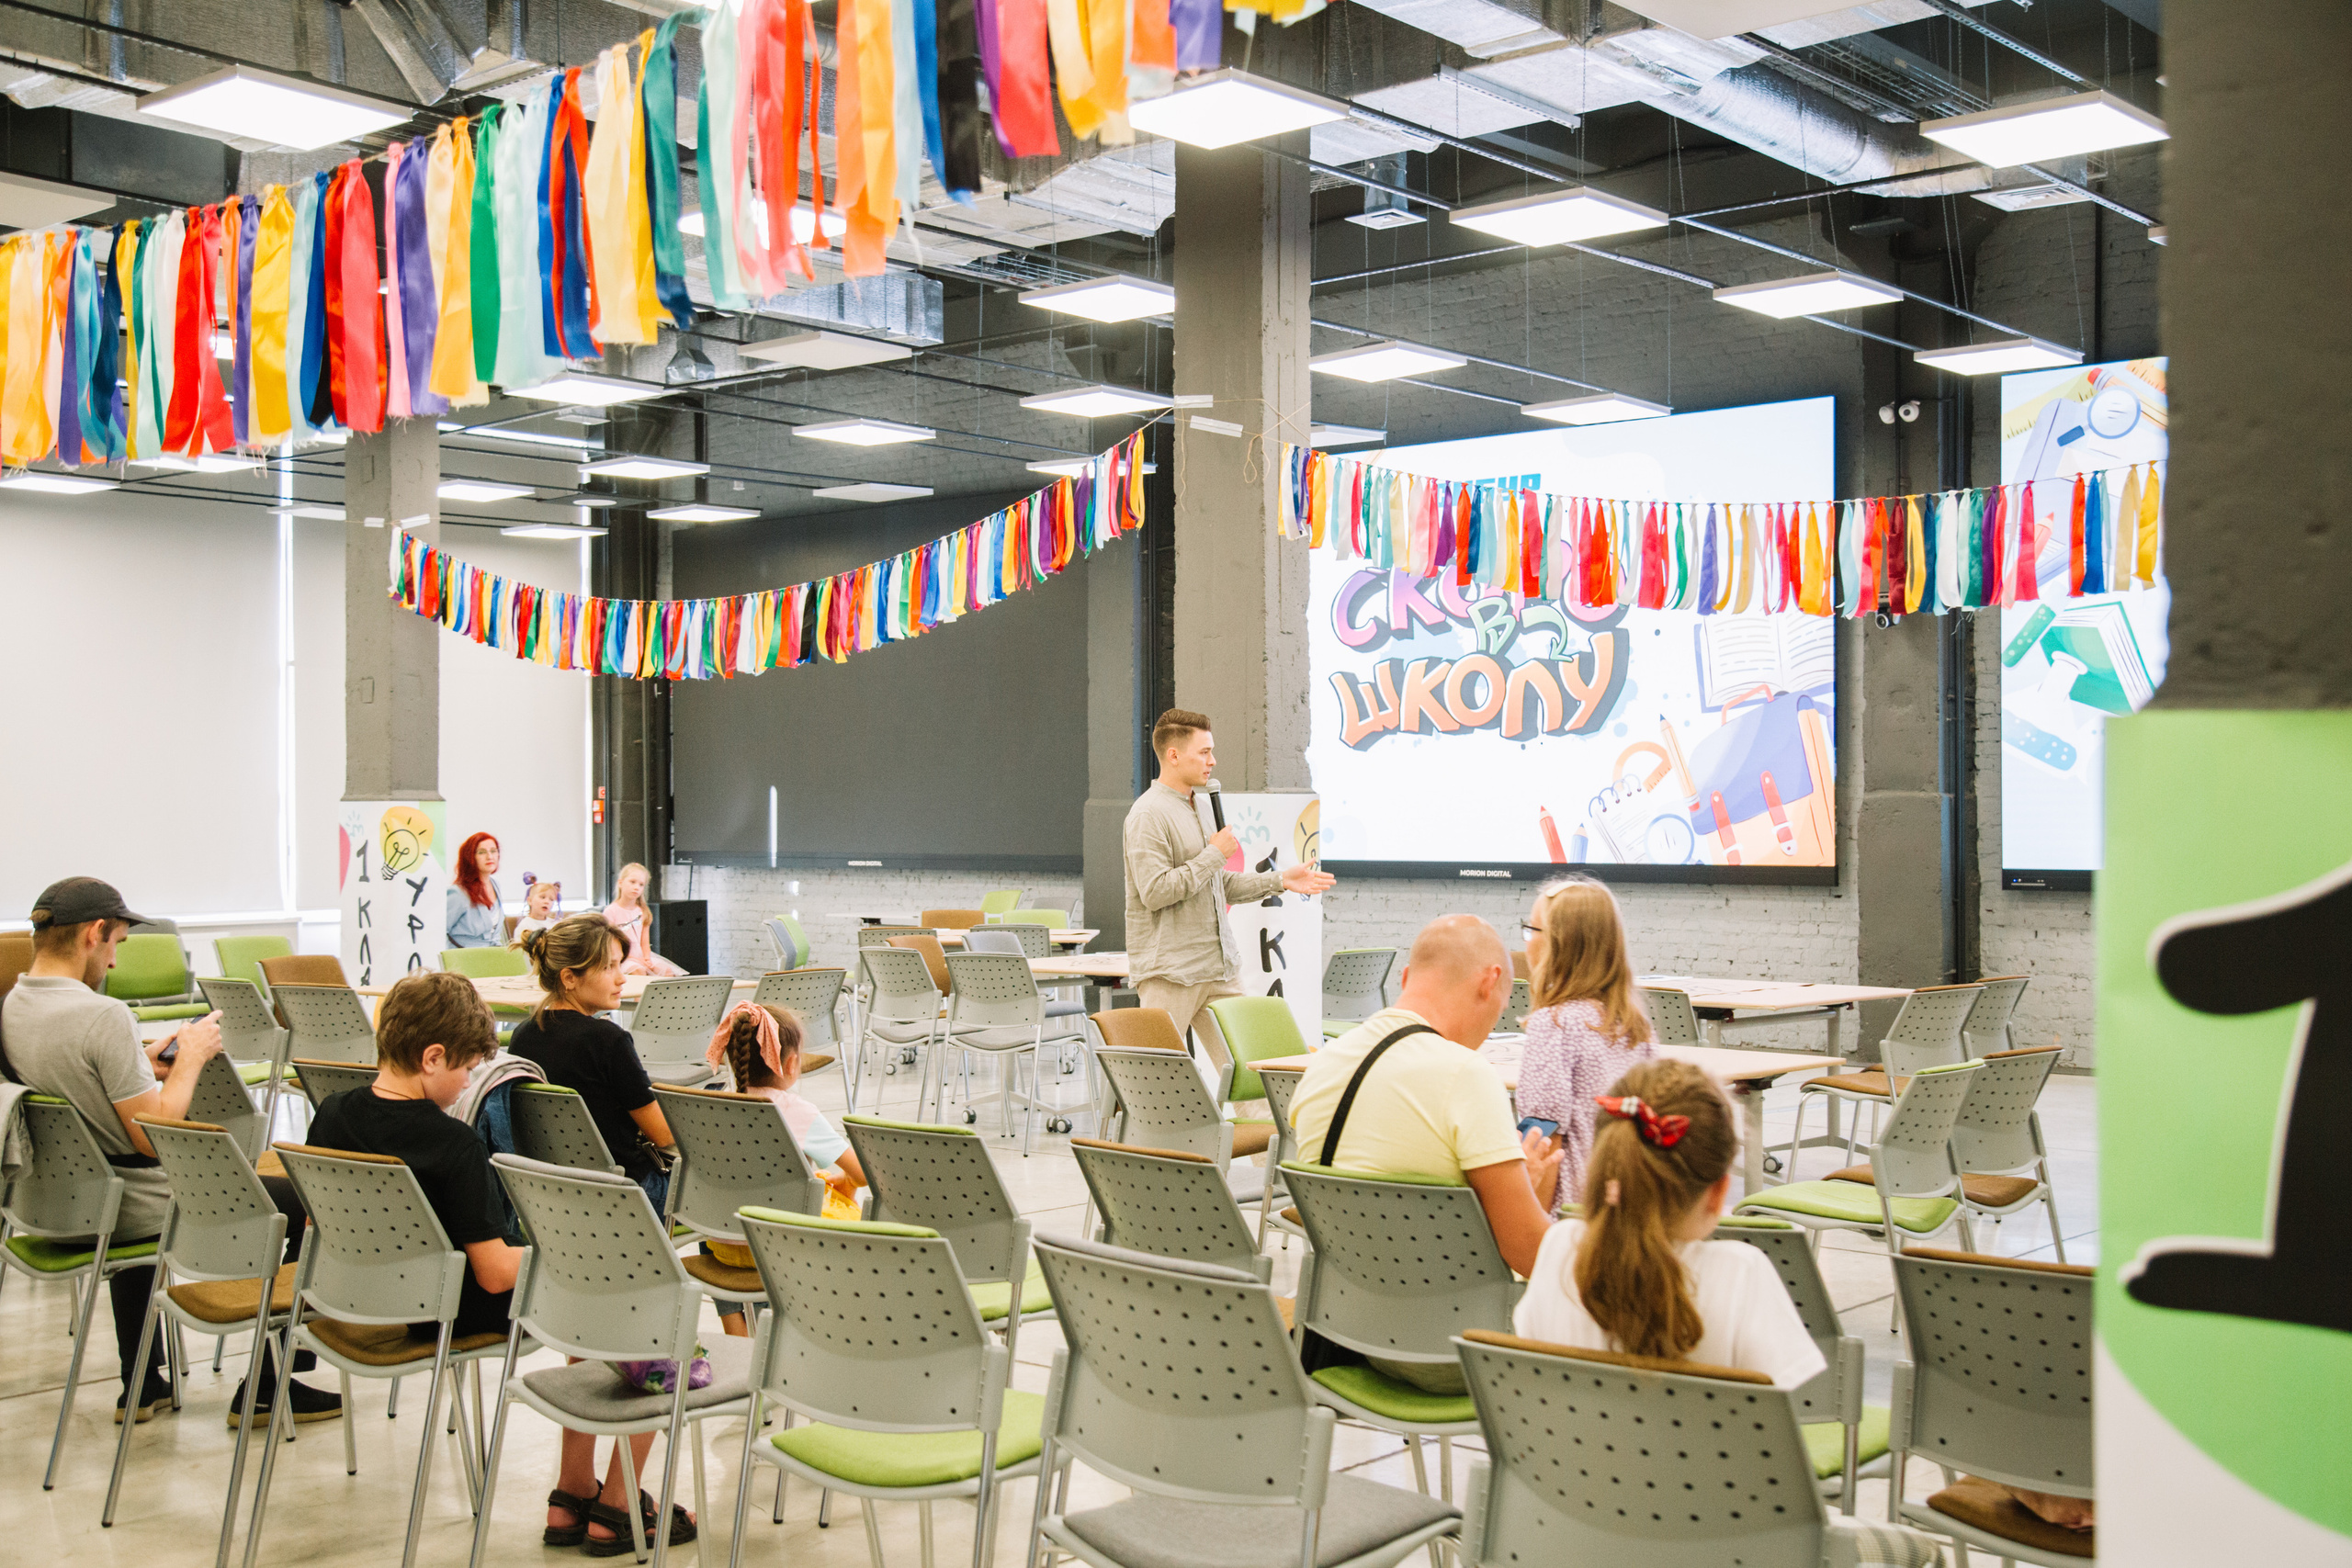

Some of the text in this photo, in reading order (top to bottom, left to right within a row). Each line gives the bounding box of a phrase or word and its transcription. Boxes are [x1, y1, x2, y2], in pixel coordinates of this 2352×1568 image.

[1466, 596, 1517, 656] В
[1329, 630, 1623, 749] ШКОЛУ
[356, 840, 370, 883] 1
[1459, 869, 1512, 878] MORION DIGITAL
